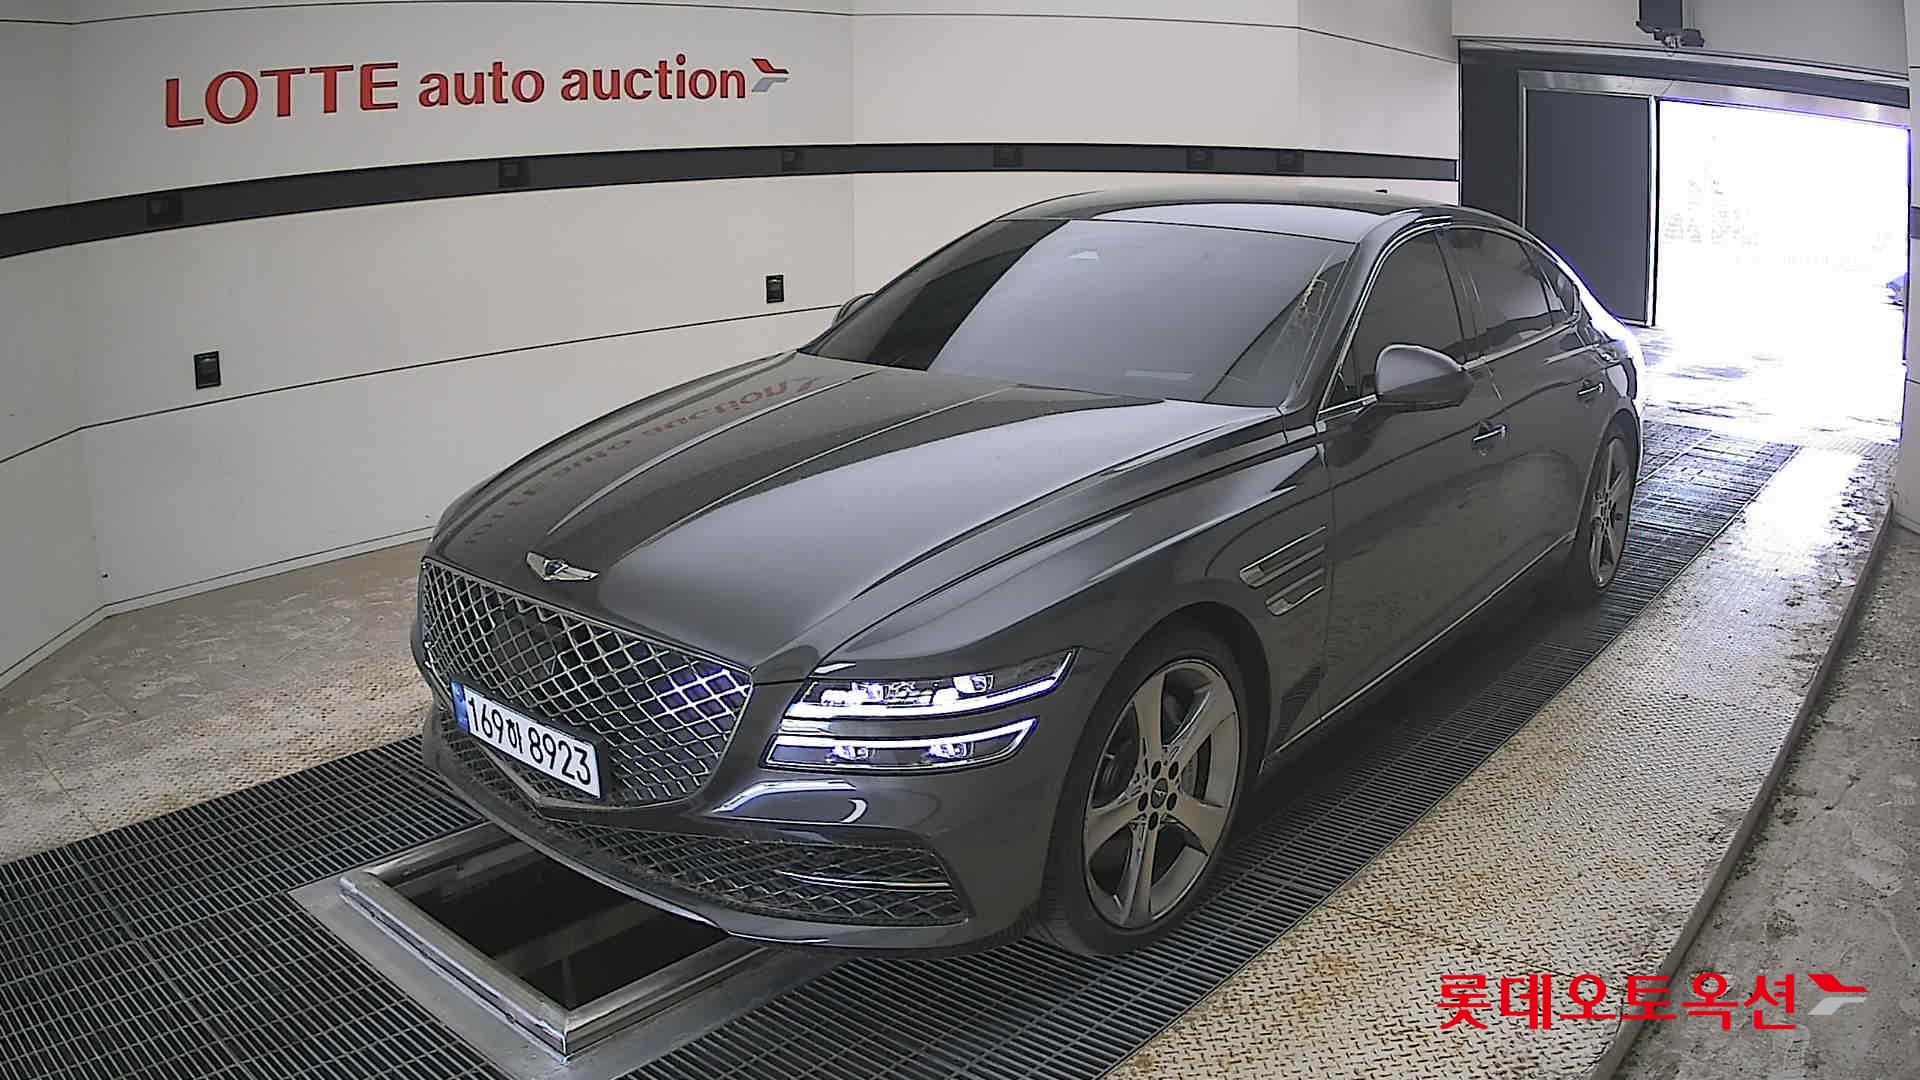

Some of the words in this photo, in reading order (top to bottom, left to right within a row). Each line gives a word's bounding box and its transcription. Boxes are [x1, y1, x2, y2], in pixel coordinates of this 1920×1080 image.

[165, 61, 399, 127] LOTTE
[418, 61, 545, 107] auto
[560, 53, 747, 101] auction
[528, 727, 591, 785] 8923
